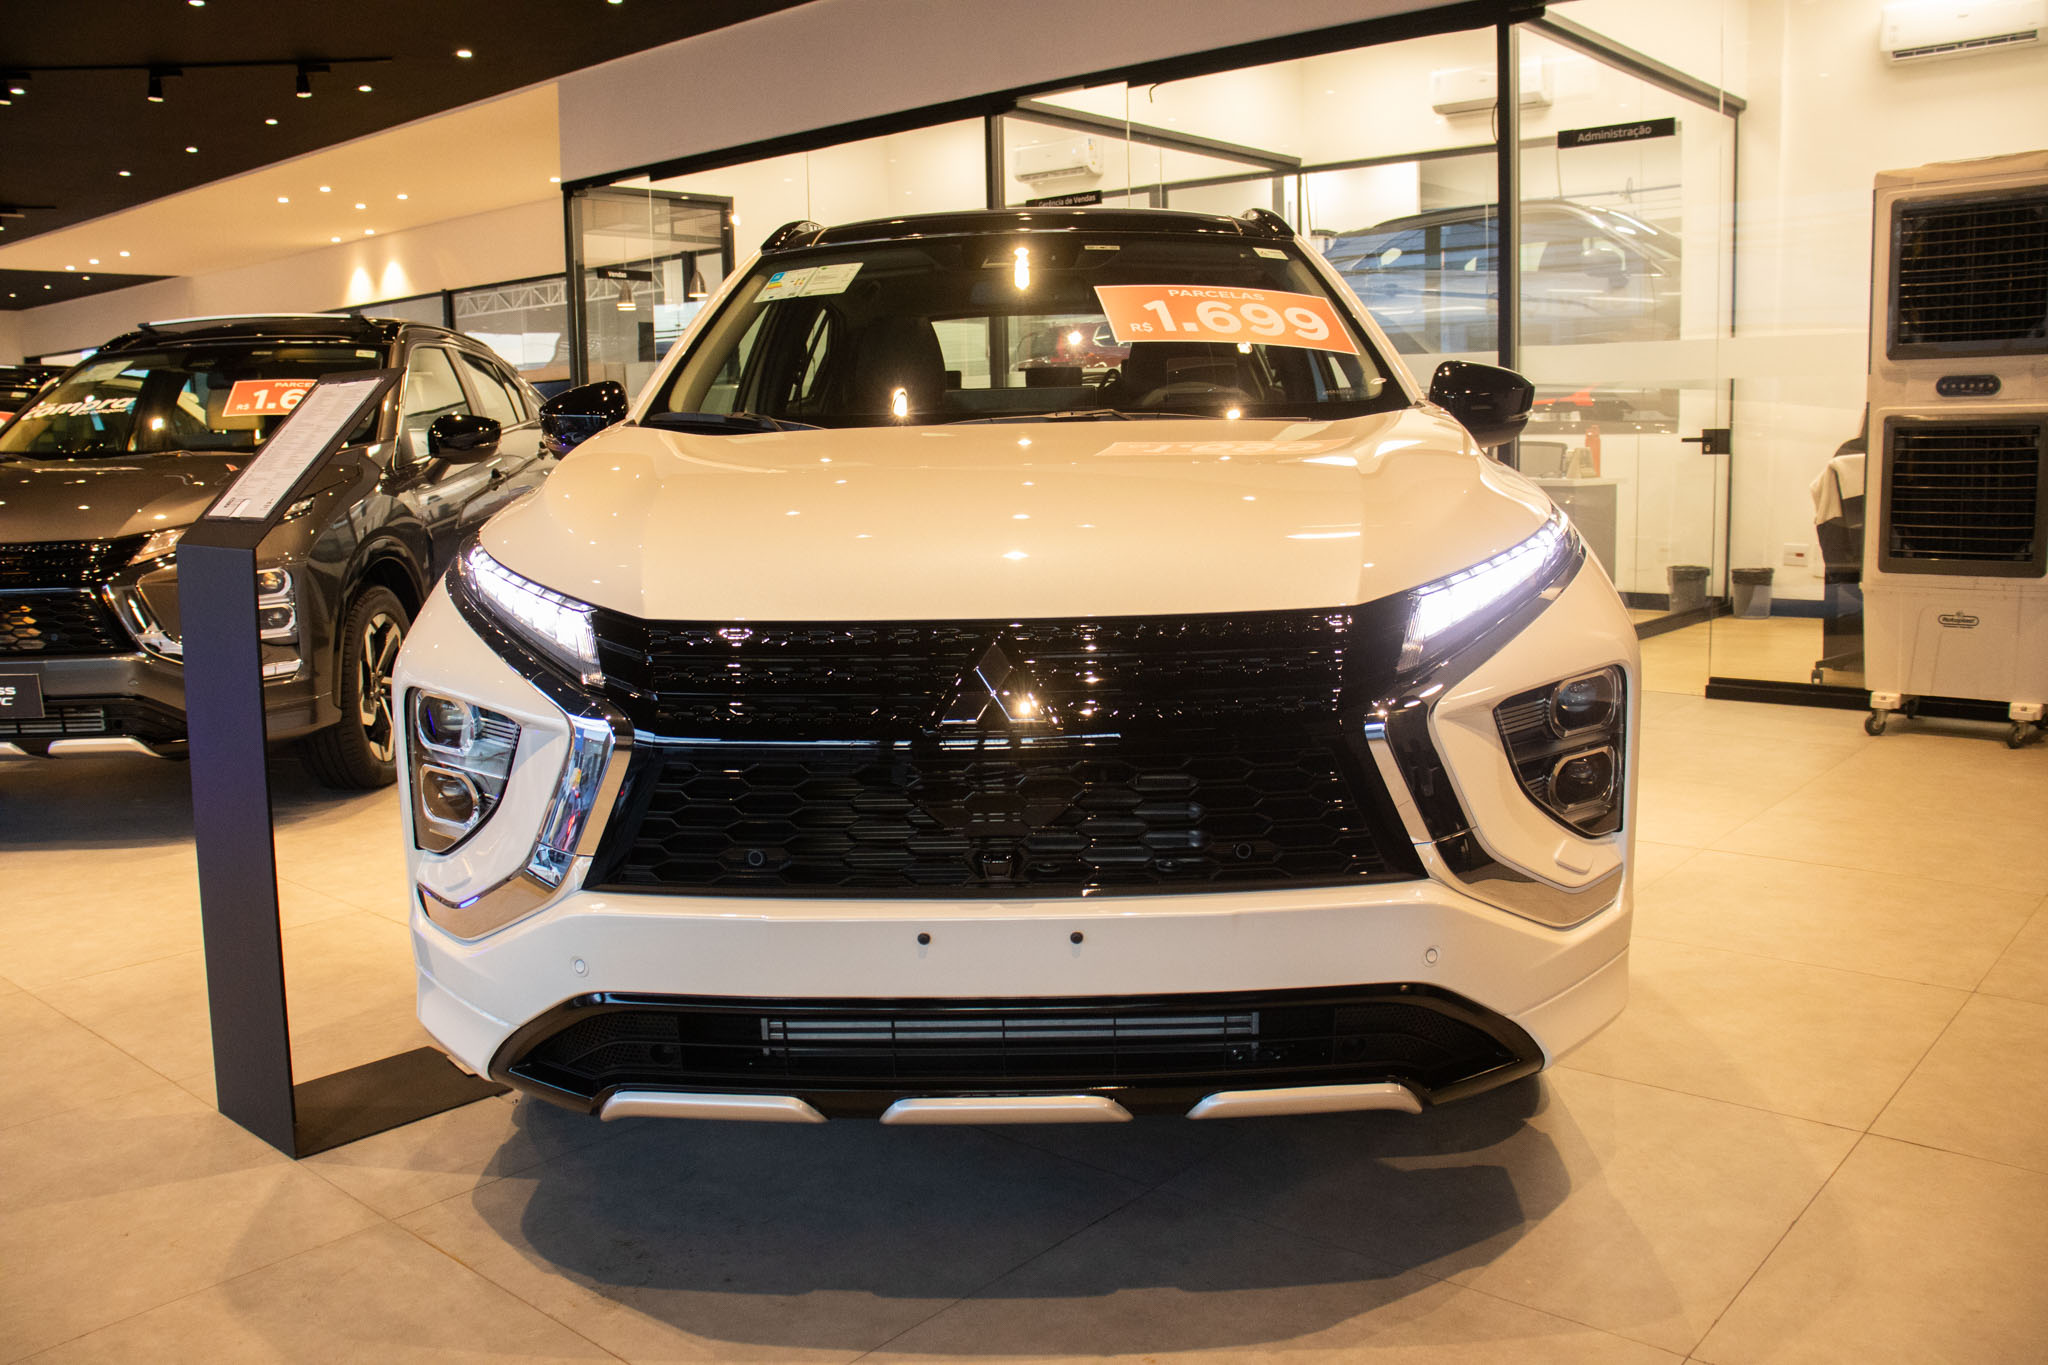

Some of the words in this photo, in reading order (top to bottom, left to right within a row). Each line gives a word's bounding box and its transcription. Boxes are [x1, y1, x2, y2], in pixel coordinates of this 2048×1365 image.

[1577, 125, 1653, 143] Administração
[1064, 197, 1073, 205] de
[1073, 194, 1096, 204] Vendas
[607, 270, 628, 279] Vendas
[1167, 289, 1266, 301] PARCELAS
[1129, 321, 1154, 333] R$
[1142, 300, 1330, 341] 1.699
[235, 403, 250, 411] R$
[253, 388, 307, 410] 1.6
